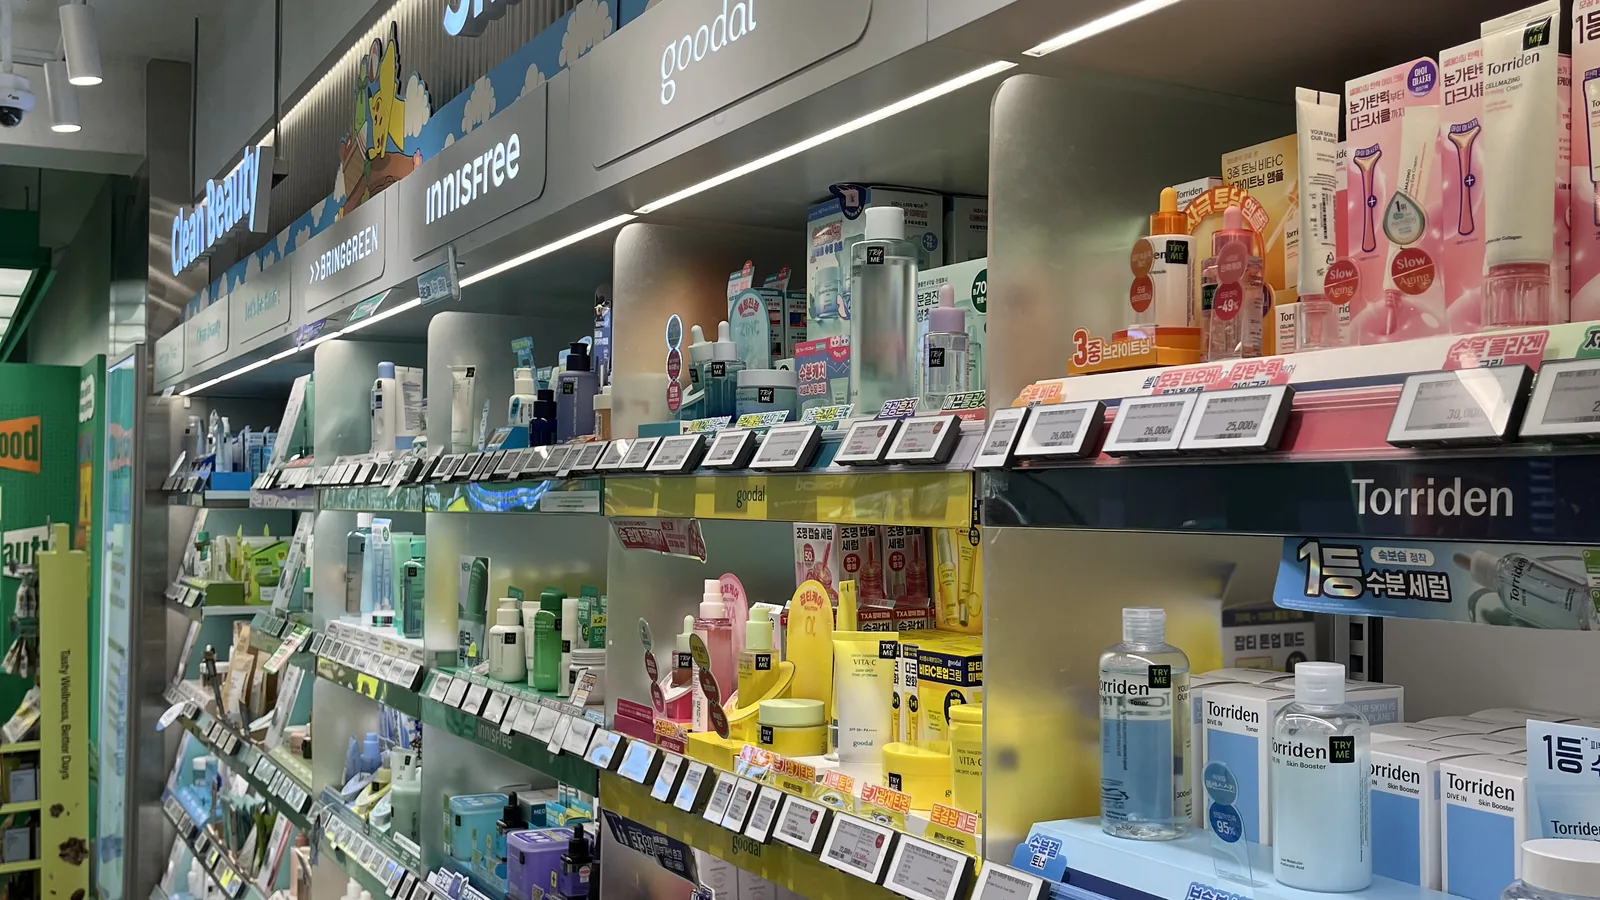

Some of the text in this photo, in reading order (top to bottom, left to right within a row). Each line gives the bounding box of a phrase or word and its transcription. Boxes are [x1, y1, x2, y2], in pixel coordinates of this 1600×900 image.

[660, 0, 757, 105] goodal
[1414, 65, 1428, 77] 아이
[1486, 52, 1540, 77] Torriden
[1485, 75, 1521, 90] CELLMAZING
[1258, 153, 1284, 171] 비타C
[1267, 168, 1284, 184] 앰플
[171, 146, 260, 277] Clean Beauty
[1241, 196, 1270, 233] 앰플
[868, 248, 883, 256] TRY
[1168, 243, 1187, 252] TRY
[1169, 252, 1184, 260] ME
[1396, 256, 1426, 269] Slow
[1330, 268, 1354, 280] Slow
[1400, 274, 1431, 288] Aging
[1328, 284, 1354, 298] Aging
[1073, 328, 1150, 367] 3중 브라이트닝
[1487, 332, 1544, 357] 콜라겐
[930, 350, 944, 358] TRY
[1157, 373, 1181, 389] 모공
[736, 484, 766, 509] goodal
[1351, 477, 1513, 517] Torriden
[796, 527, 833, 541] 조명 캡슐 세럼
[841, 525, 876, 539] 조명 캡슐
[887, 526, 905, 537] 조명
[3, 535, 49, 566] aut
[841, 540, 859, 551] 세럼
[888, 538, 905, 550] 세럼
[1299, 541, 1427, 597] 1등 속보습 정착
[1366, 571, 1450, 600] 수분 세럼
[860, 612, 872, 620] TXA
[895, 610, 908, 618] TXA
[880, 643, 896, 651] TRY
[1234, 632, 1305, 651] 잡티 톤업 패드
[904, 661, 917, 674] 다크
[947, 659, 962, 668] goodal
[1151, 668, 1169, 677] TRY
[905, 675, 917, 688] 완화
[1153, 676, 1167, 684] ME
[1207, 700, 1259, 724] Torriden
[1370, 701, 1396, 713] SKIN IS
[59, 650, 72, 781] Tasty Wellness, Better Days
[1367, 711, 1396, 722] PLANET
[1206, 718, 1217, 726] DIVE
[1245, 725, 1259, 733] Toner
[852, 740, 874, 748] goodal
[1332, 740, 1352, 750] TRY
[1335, 750, 1351, 759] ME
[1542, 733, 1583, 775] 1등
[1285, 760, 1327, 770] Skin Booster
[890, 776, 900, 784] TRY
[1446, 772, 1515, 802] Torriden
[1387, 782, 1399, 791] Skin
[1399, 784, 1420, 795] Booster
[1446, 792, 1515, 813] DIVE IN Skin Booster
[1216, 819, 1236, 836] 95%
[731, 835, 761, 858] goodal
[1029, 834, 1060, 859] 수분결
[1030, 854, 1047, 869] 토너
